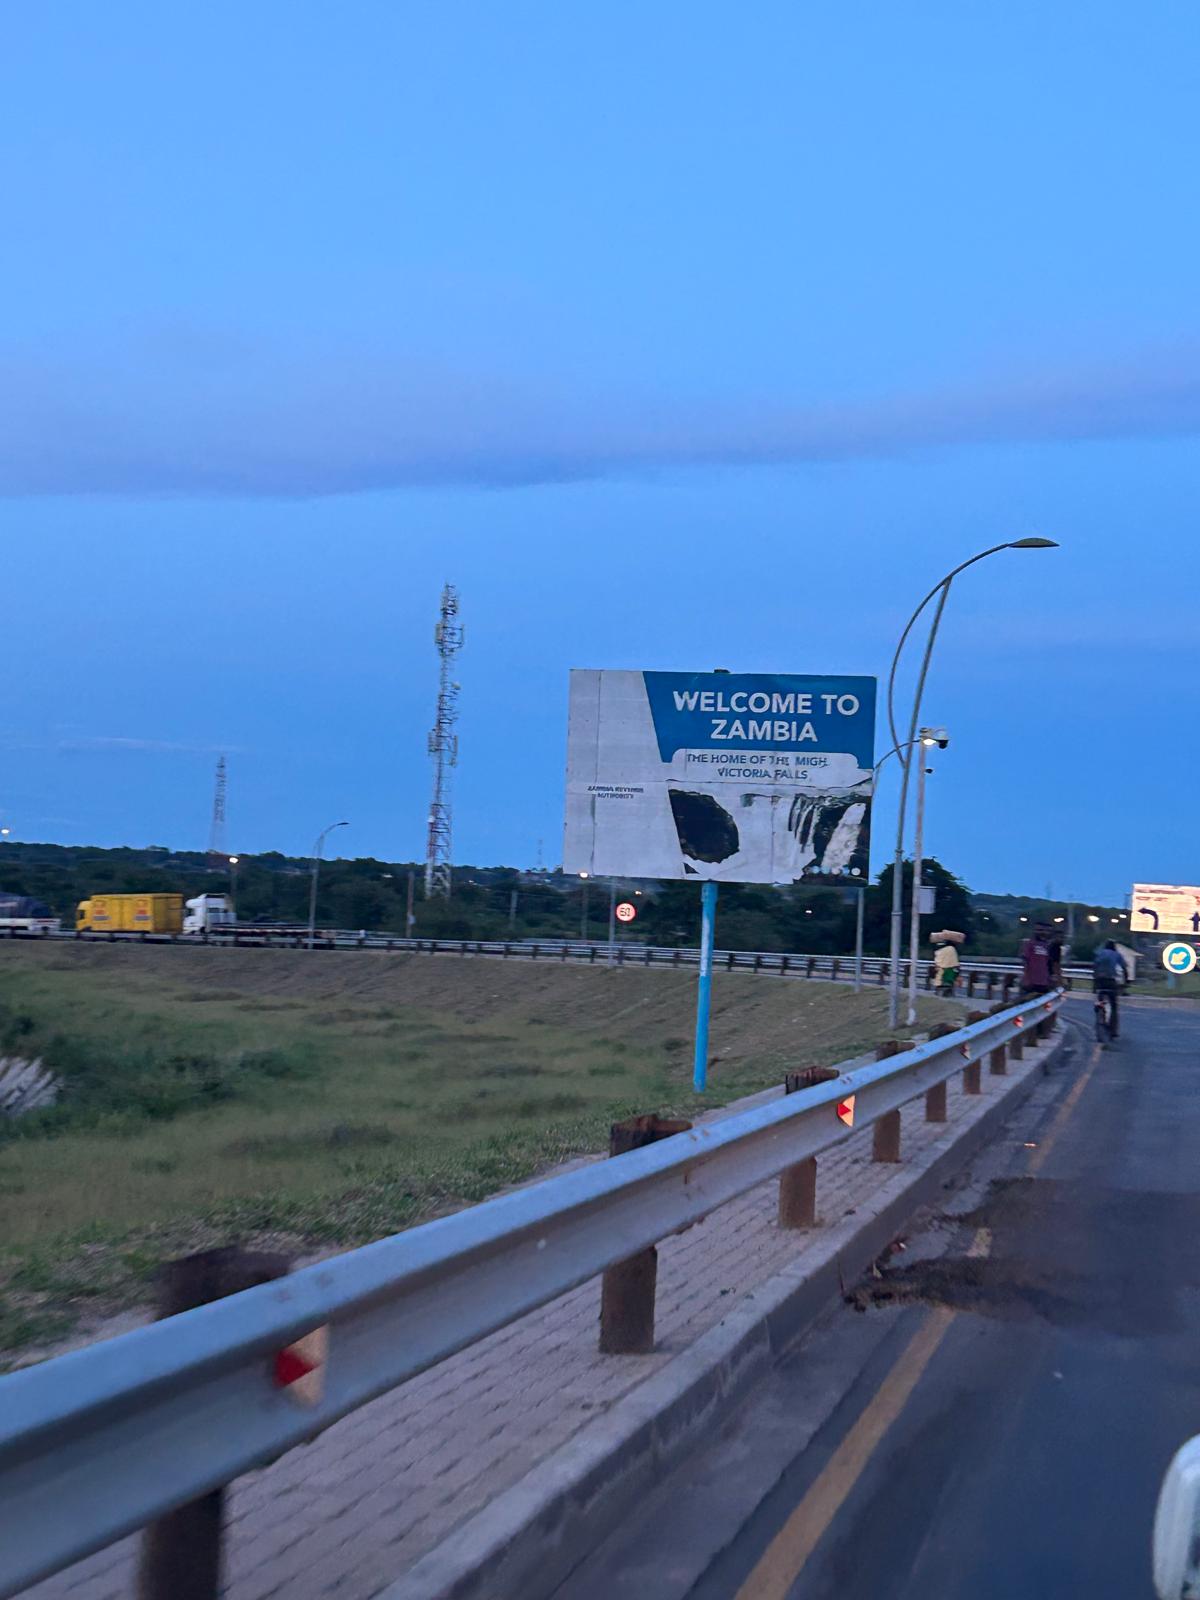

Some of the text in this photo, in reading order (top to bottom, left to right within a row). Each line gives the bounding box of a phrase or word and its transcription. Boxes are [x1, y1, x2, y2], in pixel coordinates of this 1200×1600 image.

[673, 690, 860, 716] WELCOME TO
[710, 719, 818, 742] ZAMBIA
[687, 754, 708, 763] THE
[711, 754, 746, 764] HOME
[750, 755, 766, 765] OF
[717, 767, 771, 778] VICTORIA
